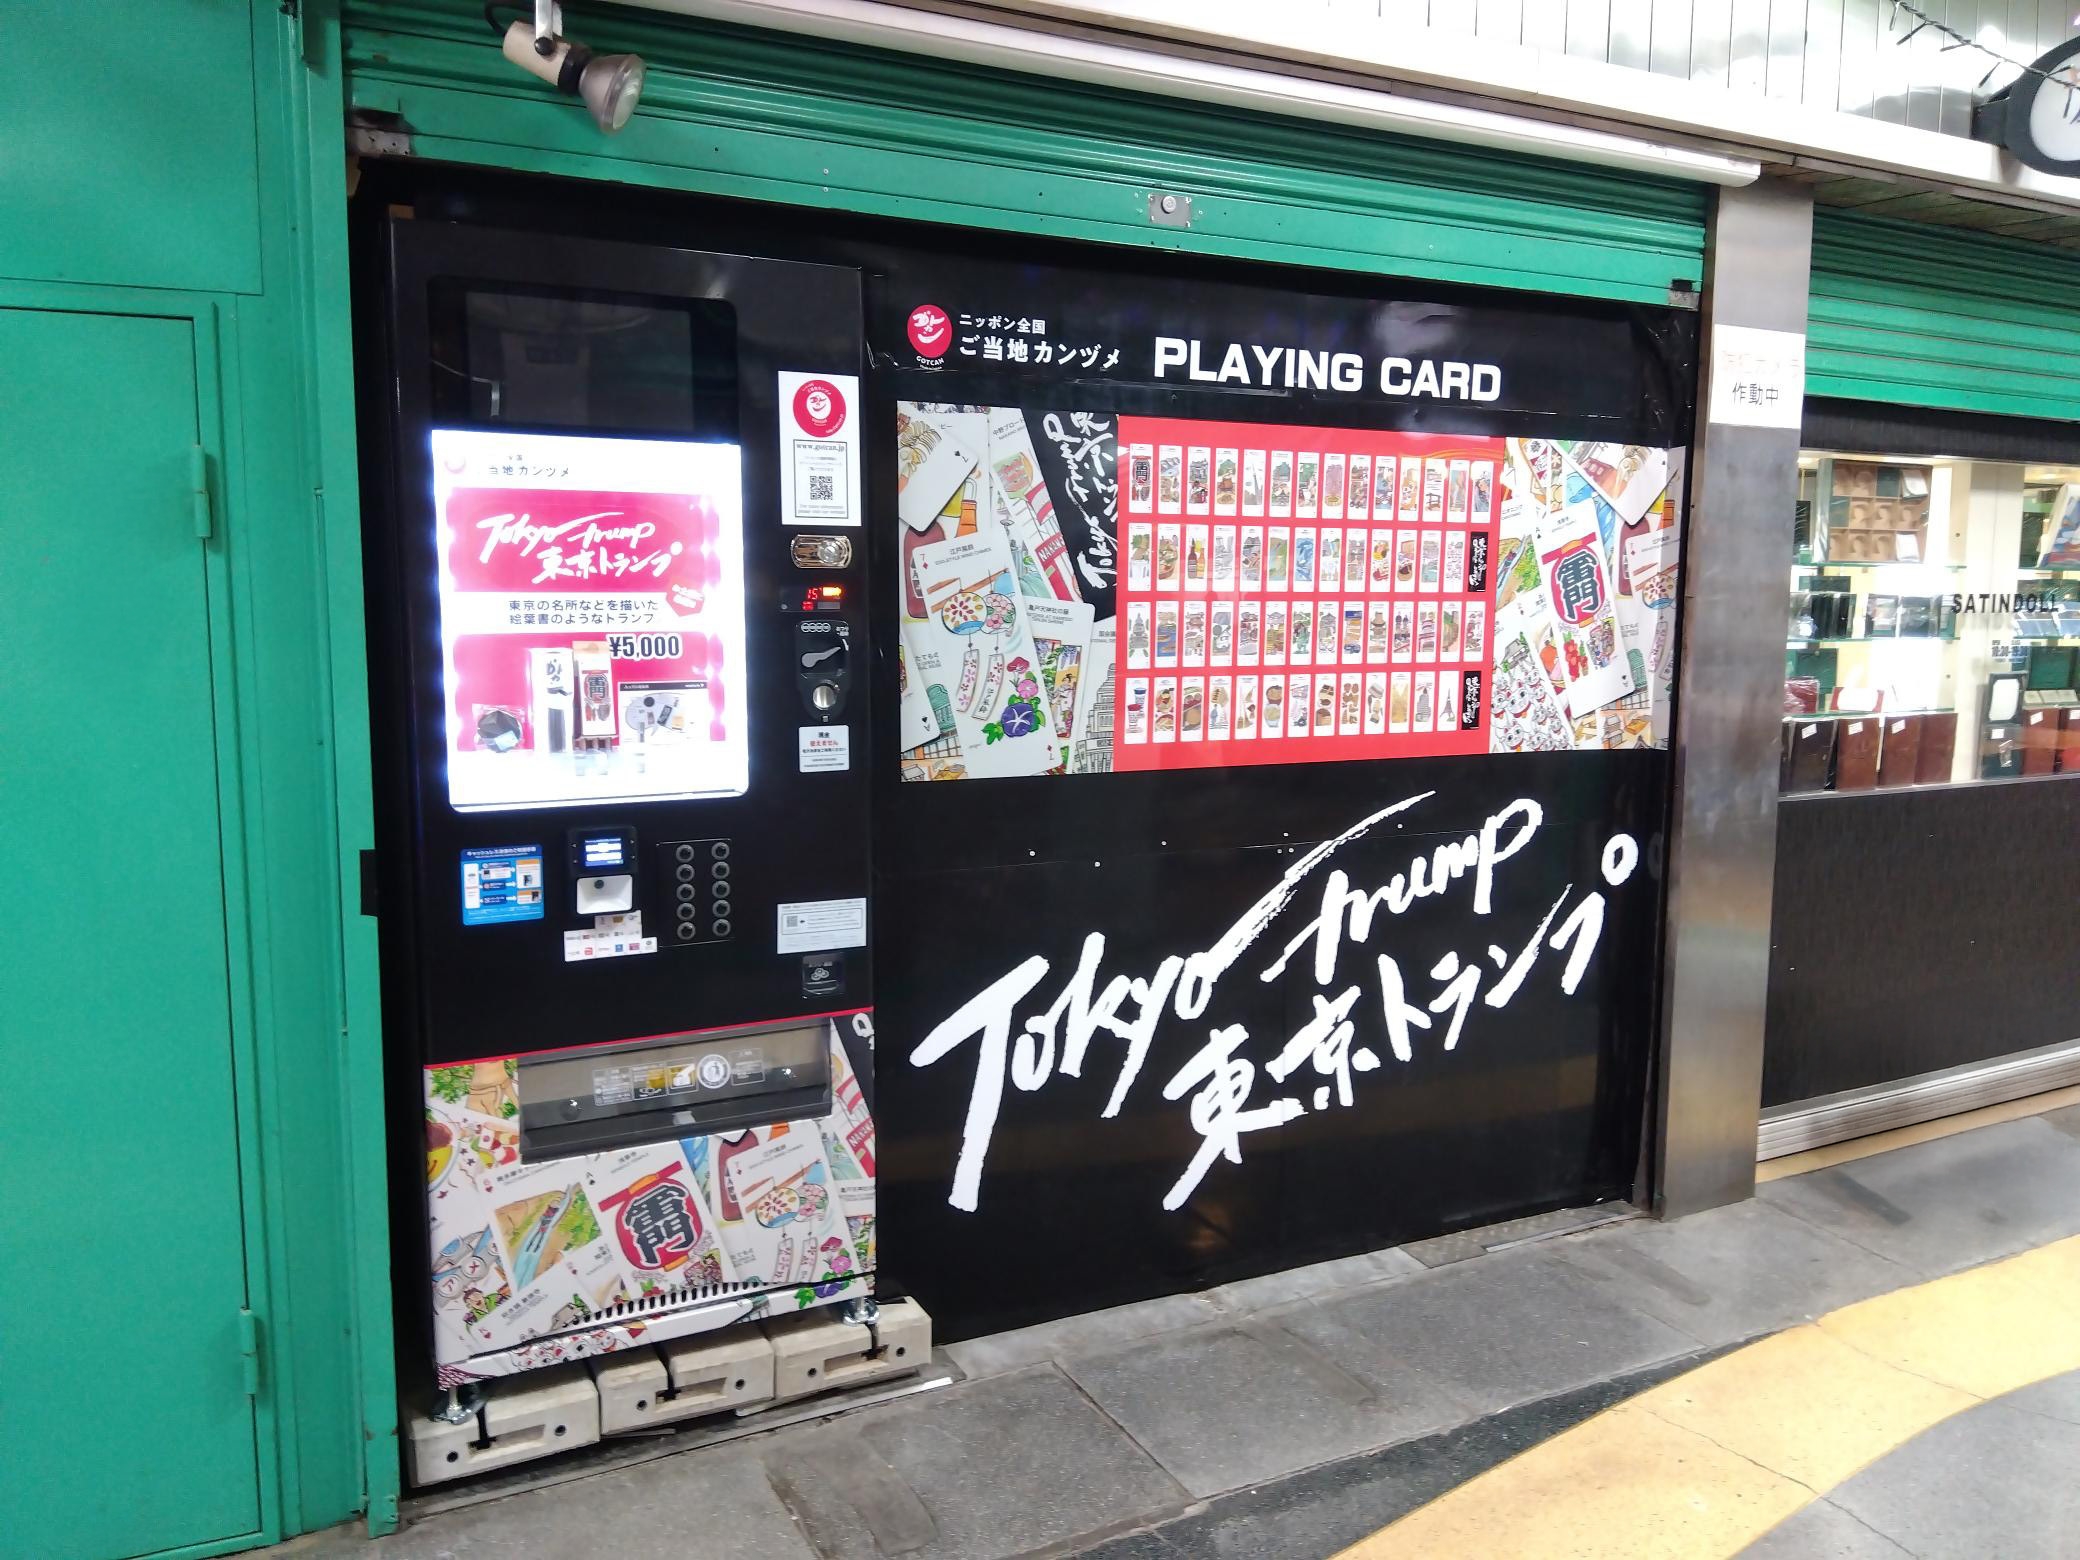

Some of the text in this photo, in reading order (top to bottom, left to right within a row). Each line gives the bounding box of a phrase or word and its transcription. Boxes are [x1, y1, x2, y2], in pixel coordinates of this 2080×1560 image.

[959, 313, 1046, 336] ニッポン全国
[915, 355, 945, 366] GOTCAN
[959, 335, 1120, 369] ご当地カンヅメ
[1154, 336, 1502, 402] PLAYING CARD
[1731, 381, 1779, 407] 作動中
[476, 512, 656, 564] Tokyo Trump
[531, 541, 683, 584] 東京トランプ
[509, 599, 658, 612] 東京の名所などを描いた
[1952, 593, 2060, 613] SATINDOLL
[609, 635, 680, 658] ¥5,000
[910, 791, 1543, 1212] Tokyo Trump
[1163, 834, 1639, 1211] 東京トランプ
